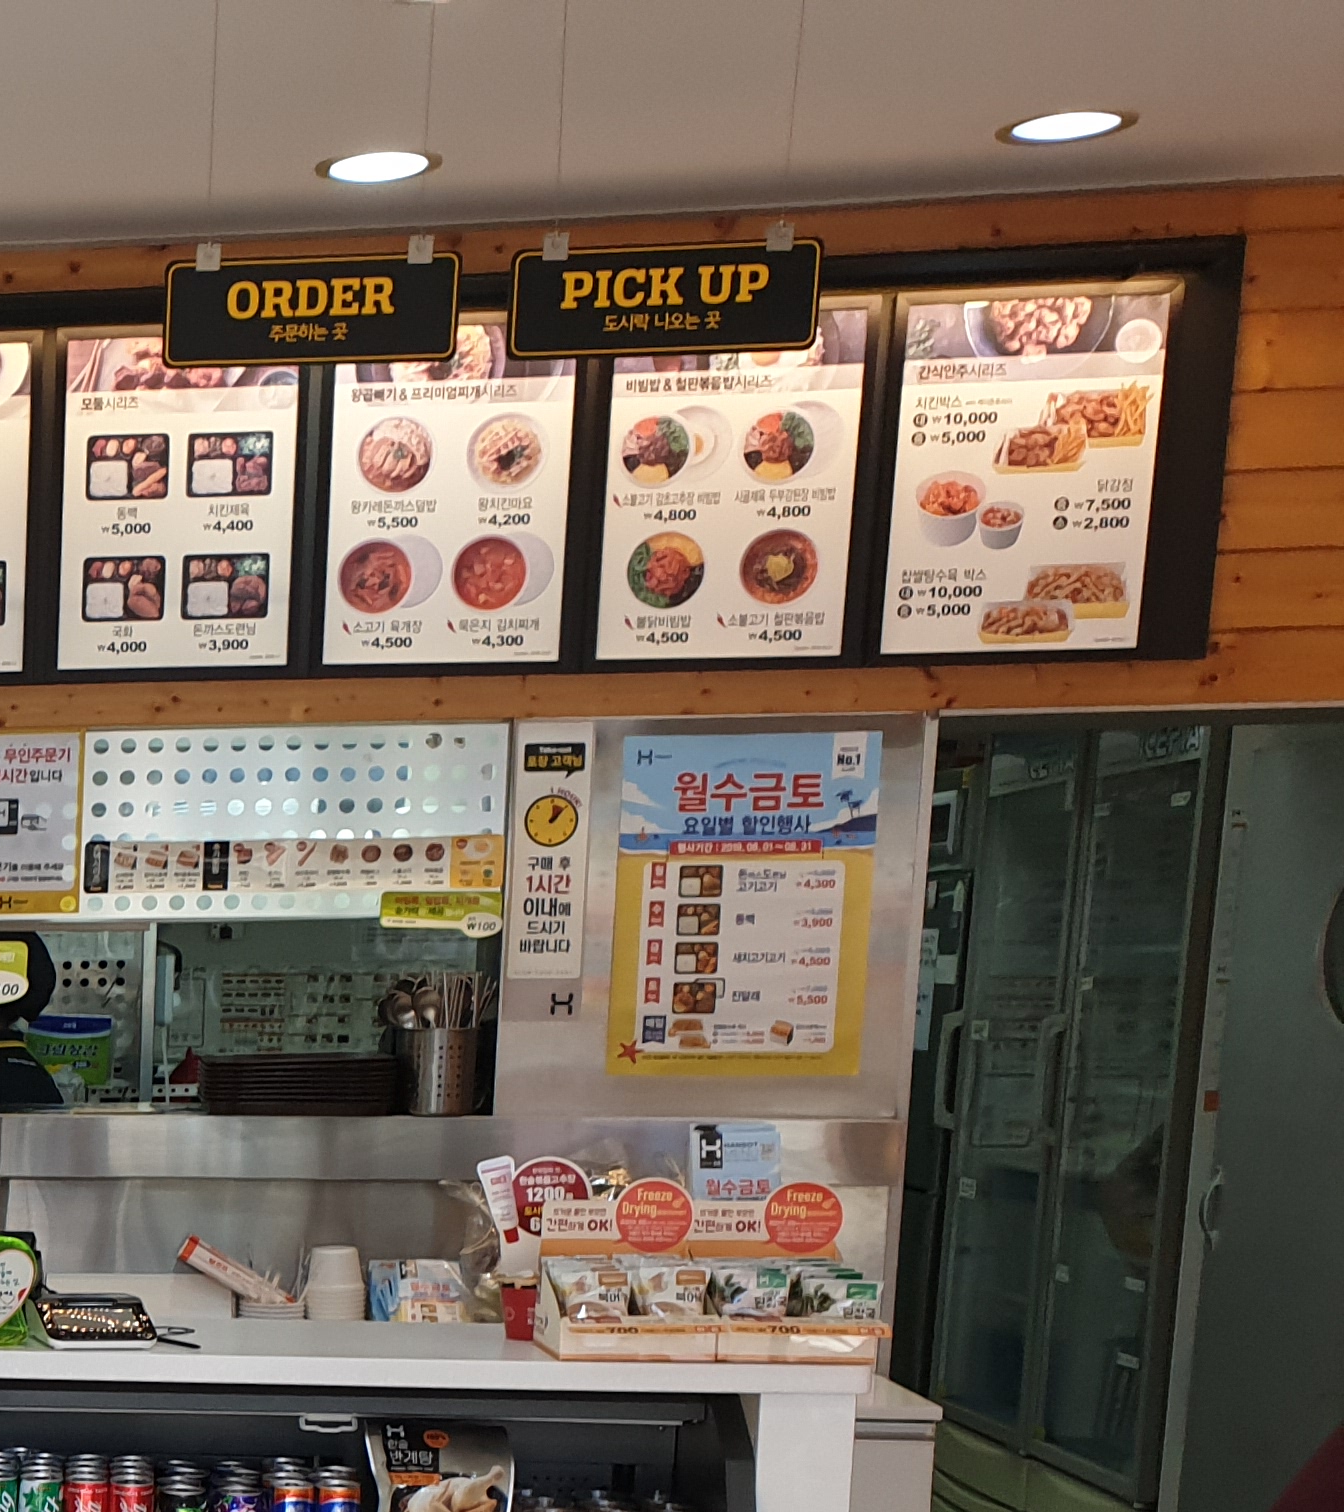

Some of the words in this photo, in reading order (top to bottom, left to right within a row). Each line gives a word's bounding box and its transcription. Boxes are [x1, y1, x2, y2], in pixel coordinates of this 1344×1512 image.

[560, 267, 685, 310] PICK
[698, 263, 770, 304] UP
[227, 276, 395, 320] ORDER
[602, 313, 650, 333] 도시락
[705, 310, 720, 329] 곳
[268, 323, 328, 341] 주문하는
[333, 321, 348, 341] 곳
[663, 379, 672, 392] &
[399, 389, 407, 400] &
[367, 517, 418, 529] ₩5,500
[478, 514, 530, 526] ₩4,200
[101, 523, 151, 535] ₩5,000
[728, 613, 769, 626] 소불고기
[352, 622, 385, 634] 소고기
[390, 621, 422, 633] 육개장
[97, 641, 147, 653] ₩4,000
[361, 637, 412, 649] ₩4,500
[4, 747, 71, 763] 무인주문기
[674, 773, 824, 813] 월수금토
[683, 817, 734, 835] 요일별
[742, 815, 811, 834] 할인행사
[528, 857, 552, 871] 구매
[559, 856, 571, 870] 후
[526, 875, 571, 894] 1시간
[524, 898, 571, 916] 이내에
[526, 921, 565, 935] 드시기
[520, 939, 570, 954] 바랍니다
[706, 1179, 770, 1196] 월수금토
[638, 1189, 672, 1201] Freeze
[787, 1189, 823, 1202] Freeze
[622, 1202, 657, 1217] Drying
[771, 1203, 807, 1219] Drying
[588, 1220, 612, 1231] OK!
[736, 1220, 761, 1233] OK!
[390, 1452, 433, 1465] 반계탕
